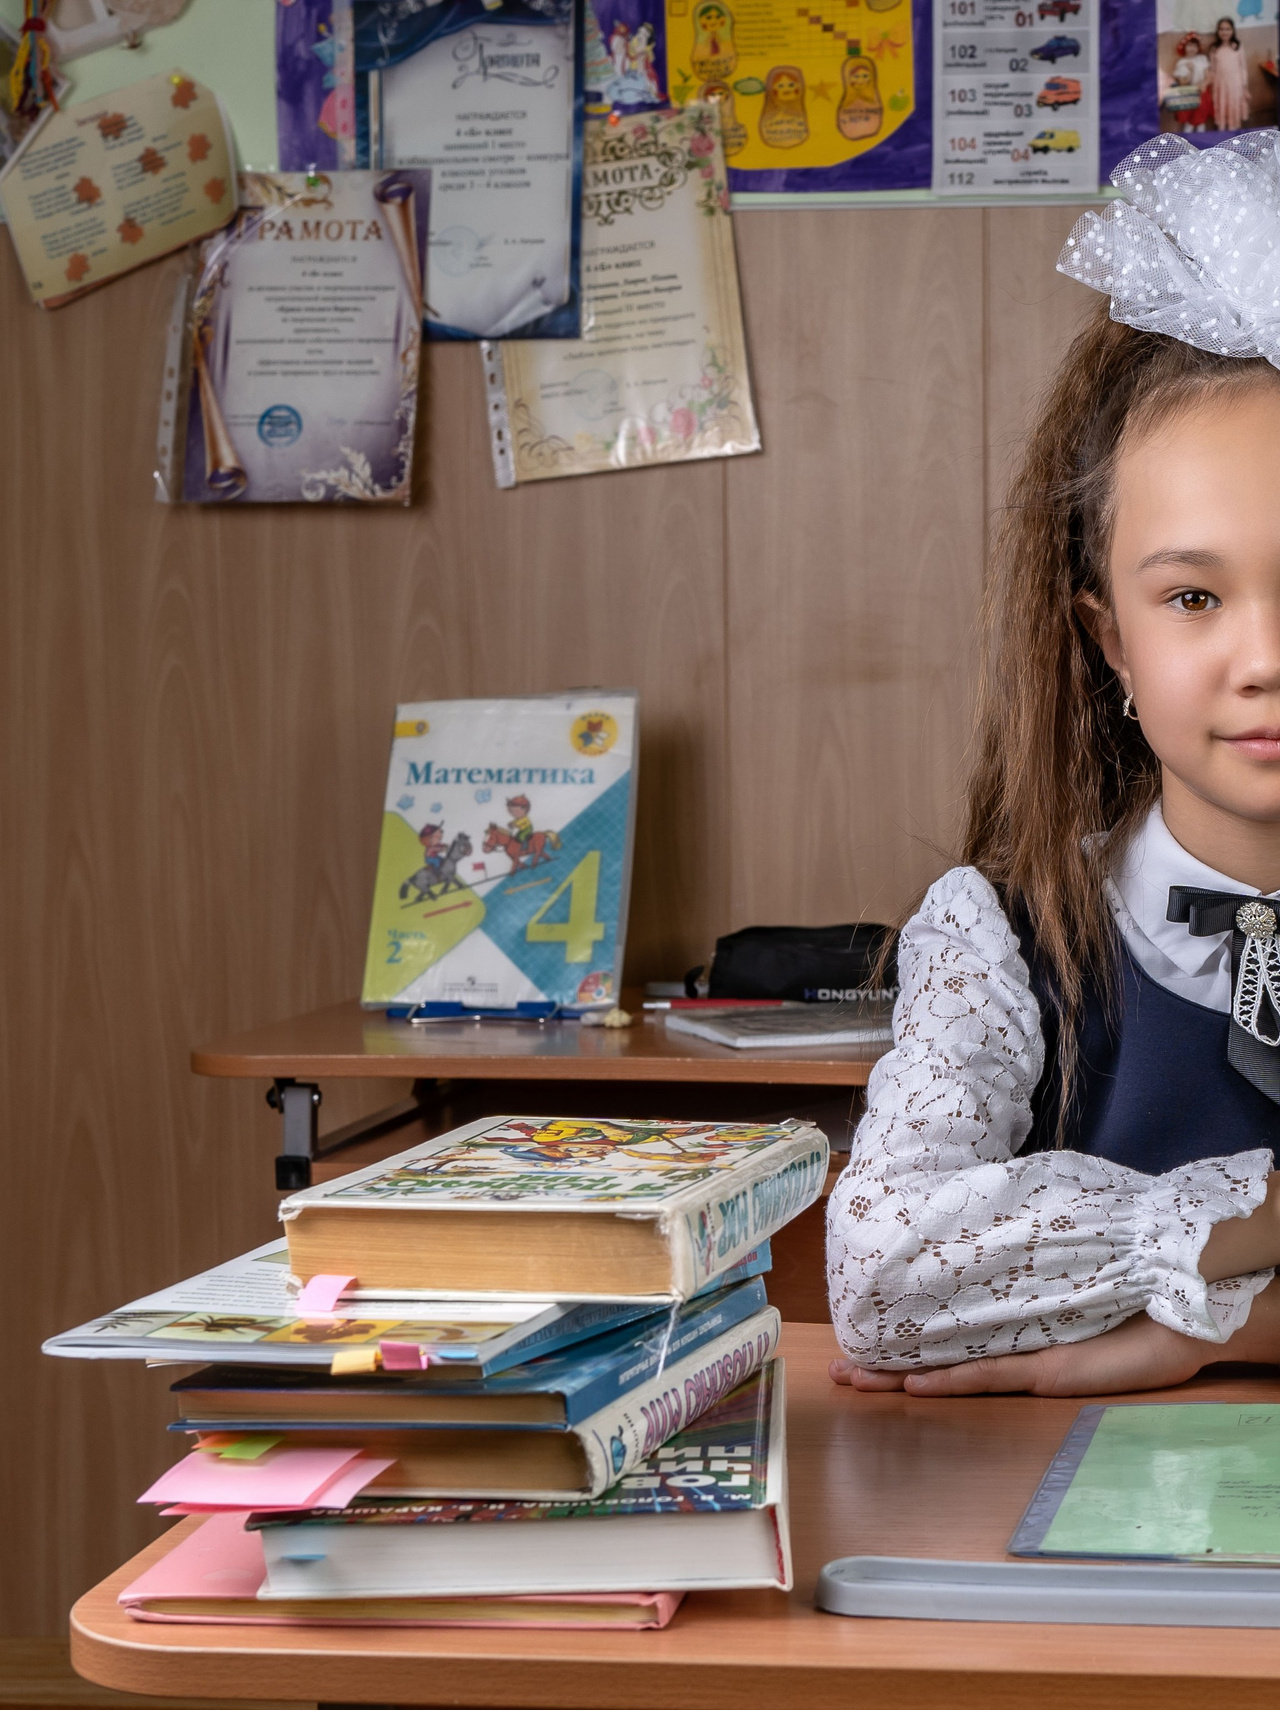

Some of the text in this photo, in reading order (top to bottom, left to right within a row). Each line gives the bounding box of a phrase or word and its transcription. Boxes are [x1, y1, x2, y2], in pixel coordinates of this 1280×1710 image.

[949, 2, 977, 15] 101
[1015, 12, 1034, 27] 01
[950, 45, 977, 59] 102
[1009, 58, 1029, 72] 02
[949, 88, 977, 102] 103
[1014, 104, 1033, 118] 03
[949, 137, 977, 151] 104
[1011, 149, 1030, 162] 04
[948, 172, 975, 185] 112
[236, 207, 383, 242] ГРАМОТА
[405, 760, 595, 786] Математика
[526, 850, 605, 963] 4
[385, 941, 402, 963] 2
[804, 987, 900, 1001] HONGYUN
[386, 1179, 623, 1192] ПОЗНАЮ
[488, 1174, 618, 1184] МИР
[684, 1341, 756, 1425] ПОЗНАЮ
[640, 1388, 682, 1457] МИР
